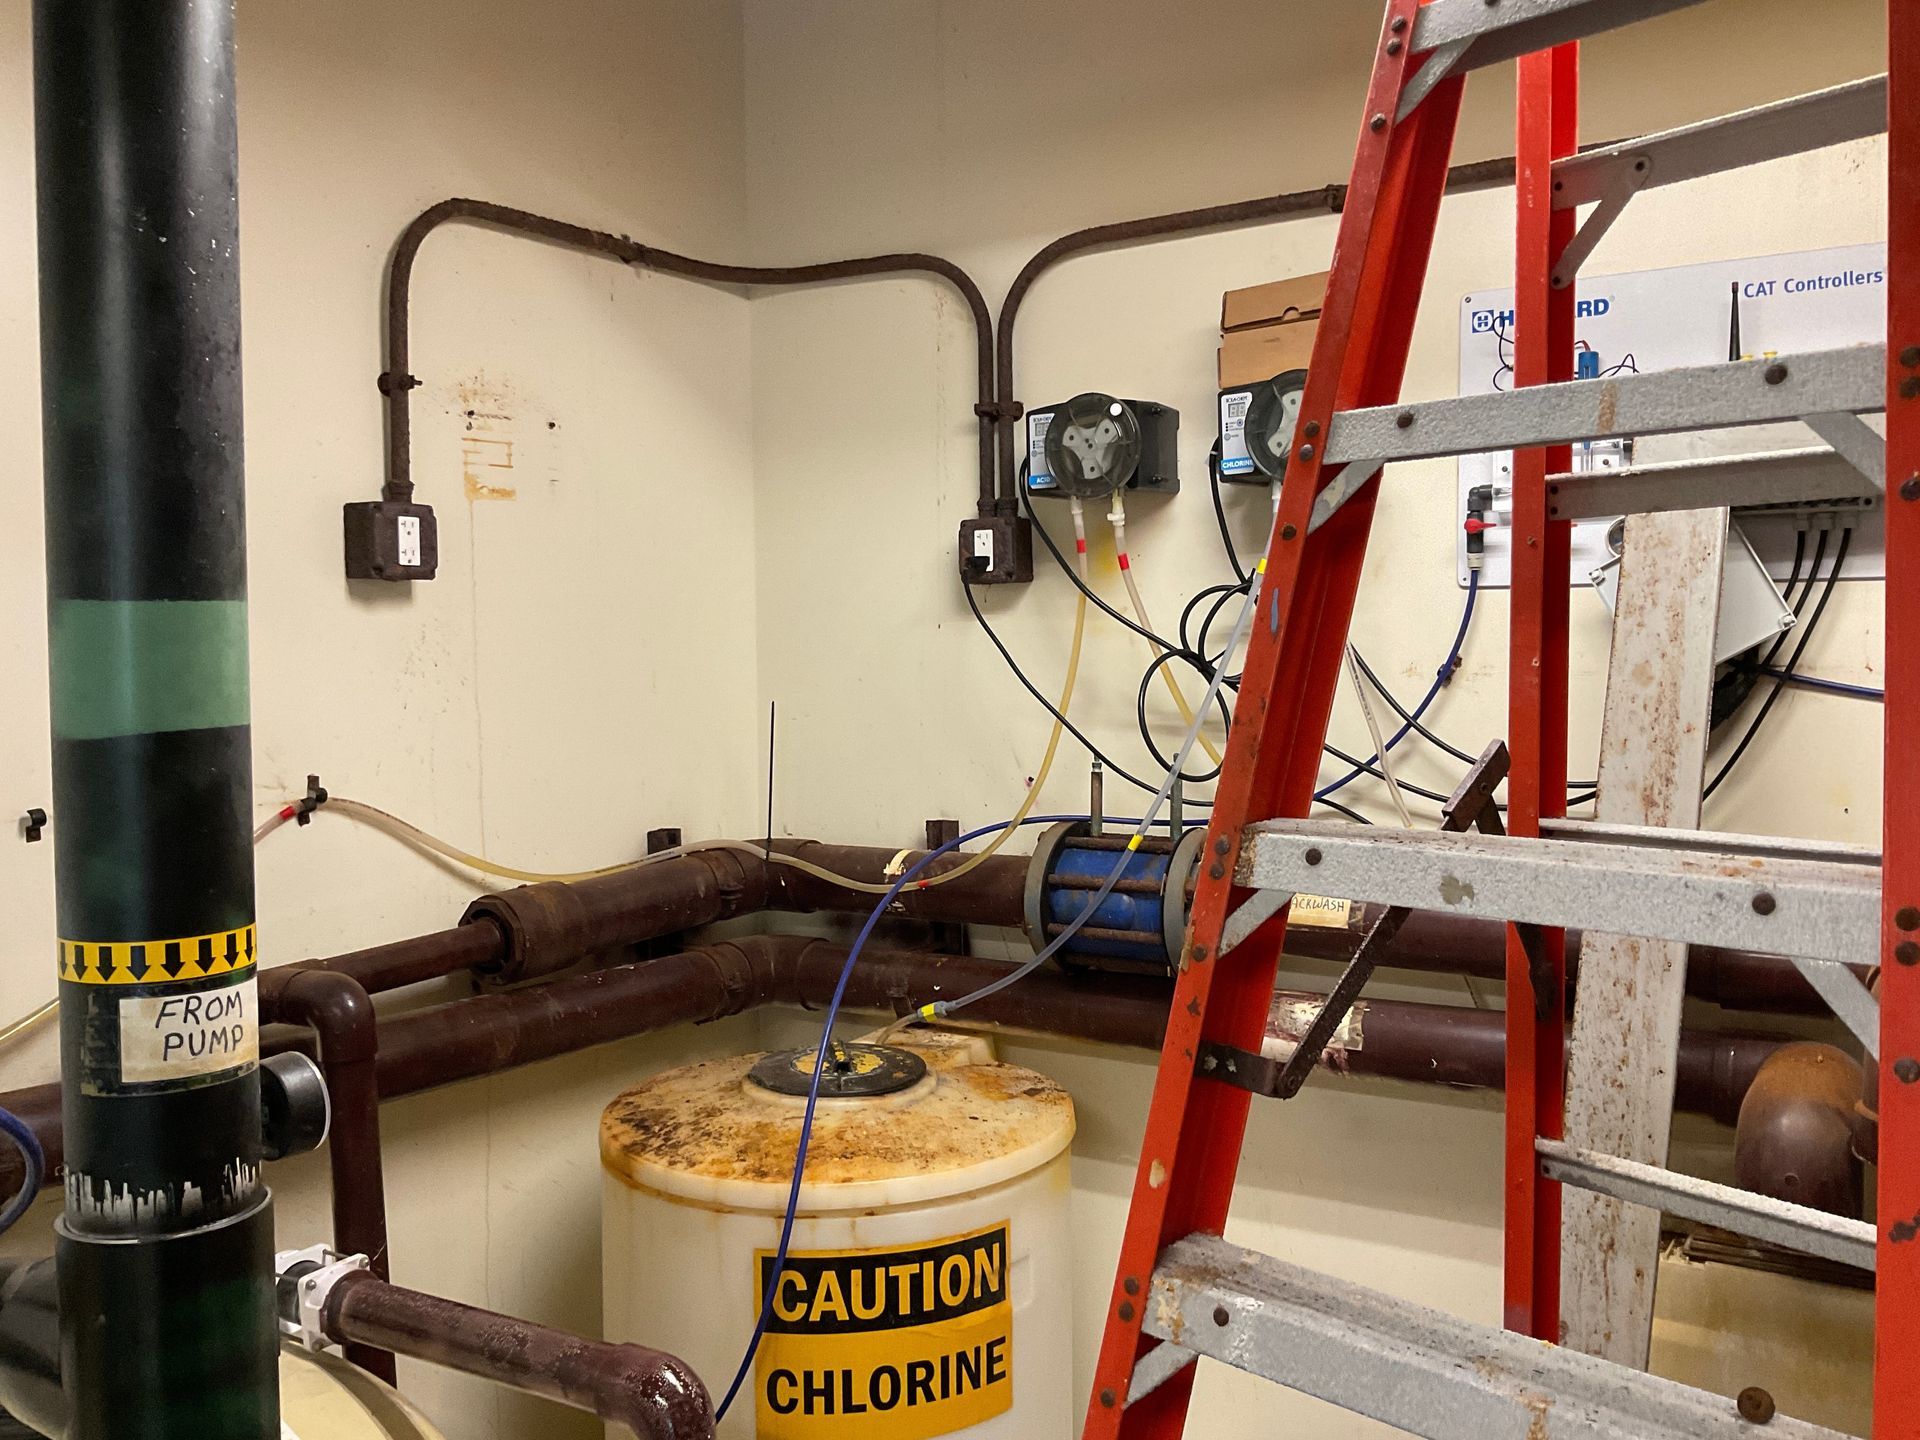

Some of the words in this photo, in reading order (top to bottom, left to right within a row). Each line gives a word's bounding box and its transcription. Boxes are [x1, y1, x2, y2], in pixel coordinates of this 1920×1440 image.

[1743, 280, 1777, 298] CAT
[1783, 270, 1884, 293] Controllers
[1036, 475, 1051, 485] ACID
[1291, 895, 1345, 912] ACKWASH
[155, 990, 243, 1029] FROM
[162, 1024, 244, 1062] PUMP
[771, 1242, 1001, 1323] CAUTION
[766, 1335, 1007, 1416] CHLORINE
